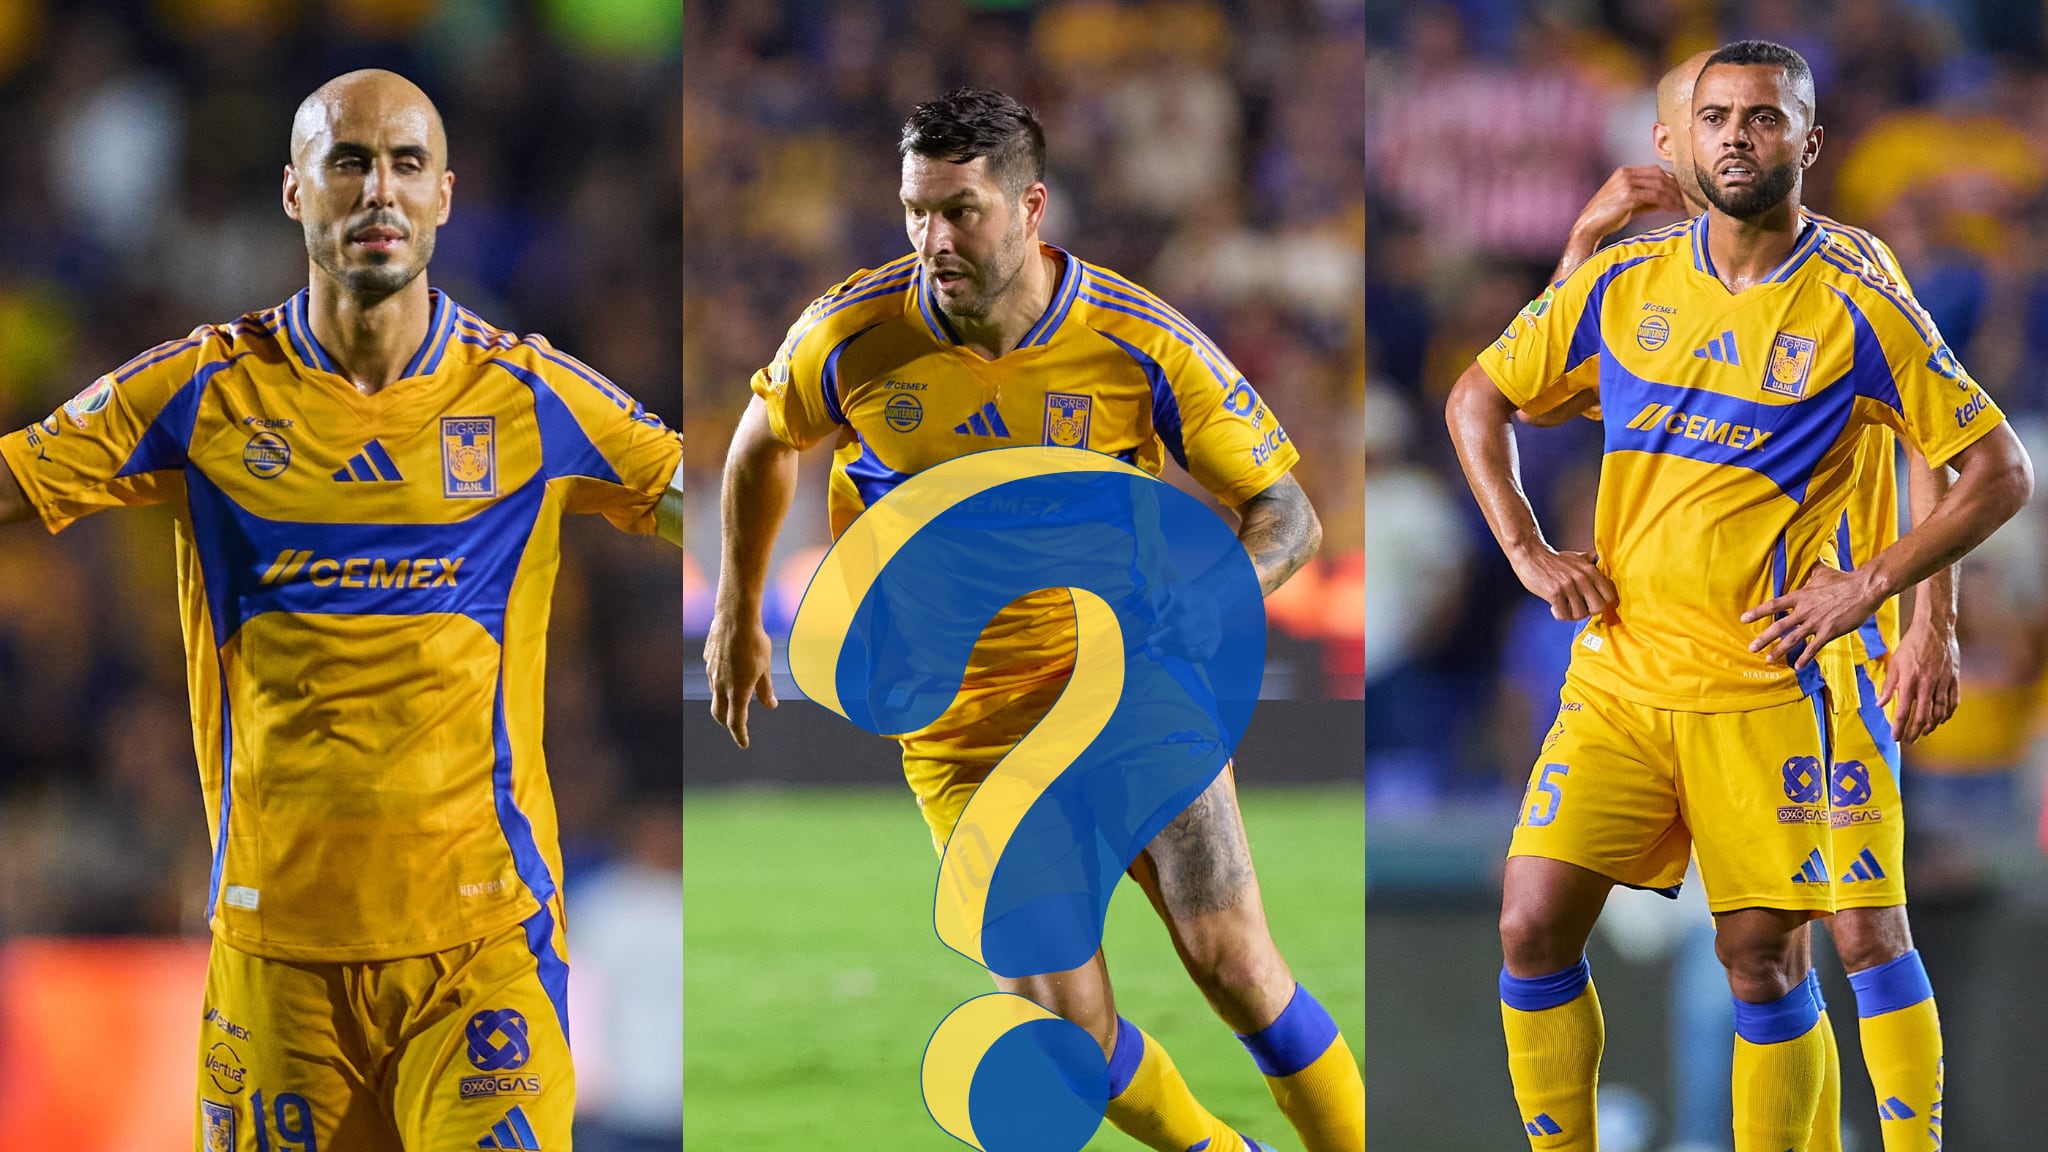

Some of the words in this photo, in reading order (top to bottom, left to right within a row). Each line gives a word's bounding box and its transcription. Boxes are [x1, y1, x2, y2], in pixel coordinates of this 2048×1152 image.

[1778, 338, 1811, 353] TIGRES
[894, 382, 928, 391] CEMEX
[1772, 381, 1793, 393] UANL
[1051, 397, 1088, 410] TIGRES
[446, 423, 489, 435] TIGRES
[1665, 412, 1773, 452] CEMEX
[456, 481, 484, 492] UANL
[309, 557, 466, 589] CEMEX
[217, 1015, 251, 1041] CEMEX
[205, 1053, 244, 1084] Vertua
[250, 1088, 319, 1152] 19
